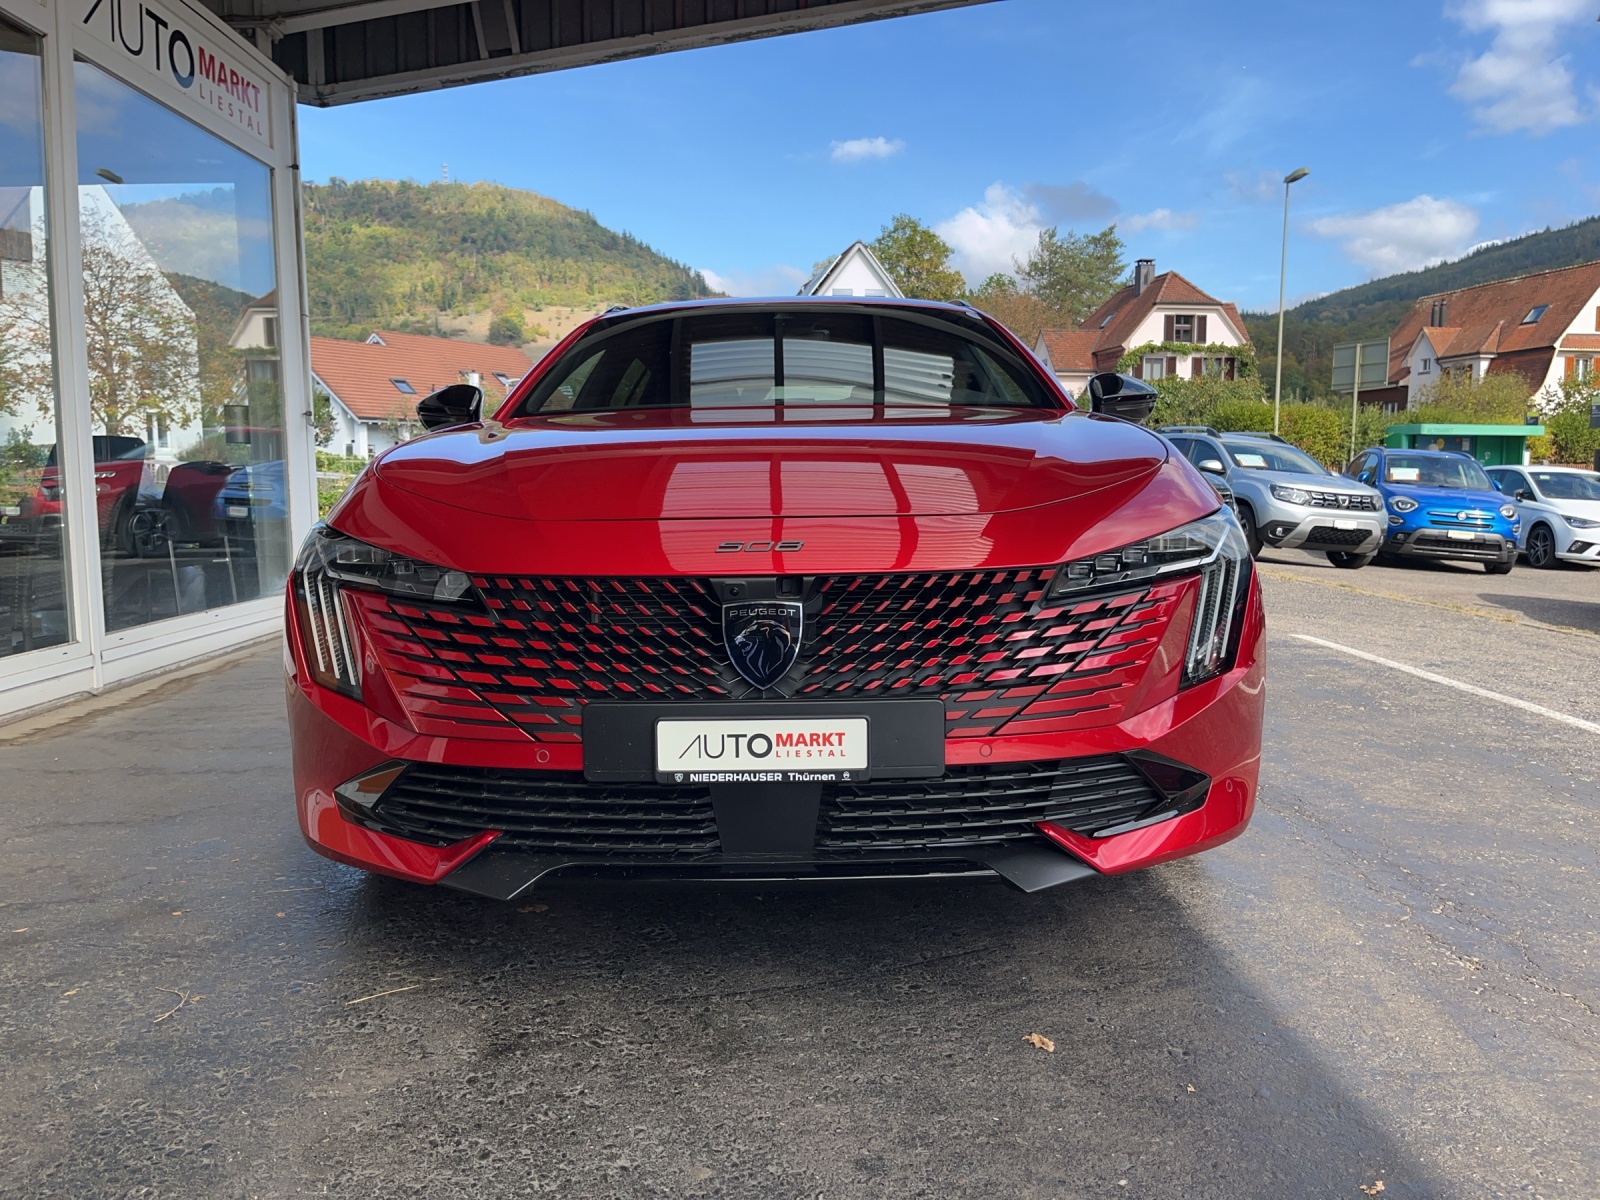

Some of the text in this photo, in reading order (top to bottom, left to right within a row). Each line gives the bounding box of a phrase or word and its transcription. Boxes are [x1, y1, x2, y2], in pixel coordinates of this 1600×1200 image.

[82, 0, 260, 113] AUTO MARKT
[199, 83, 262, 136] LIESTAL
[715, 541, 804, 553] 508
[729, 608, 796, 617] PEUGEOT
[678, 732, 846, 759] AUTO MARKT
[775, 749, 846, 758] LIESTAL
[690, 772, 836, 782] NIEDERHAUSER Thürnen
